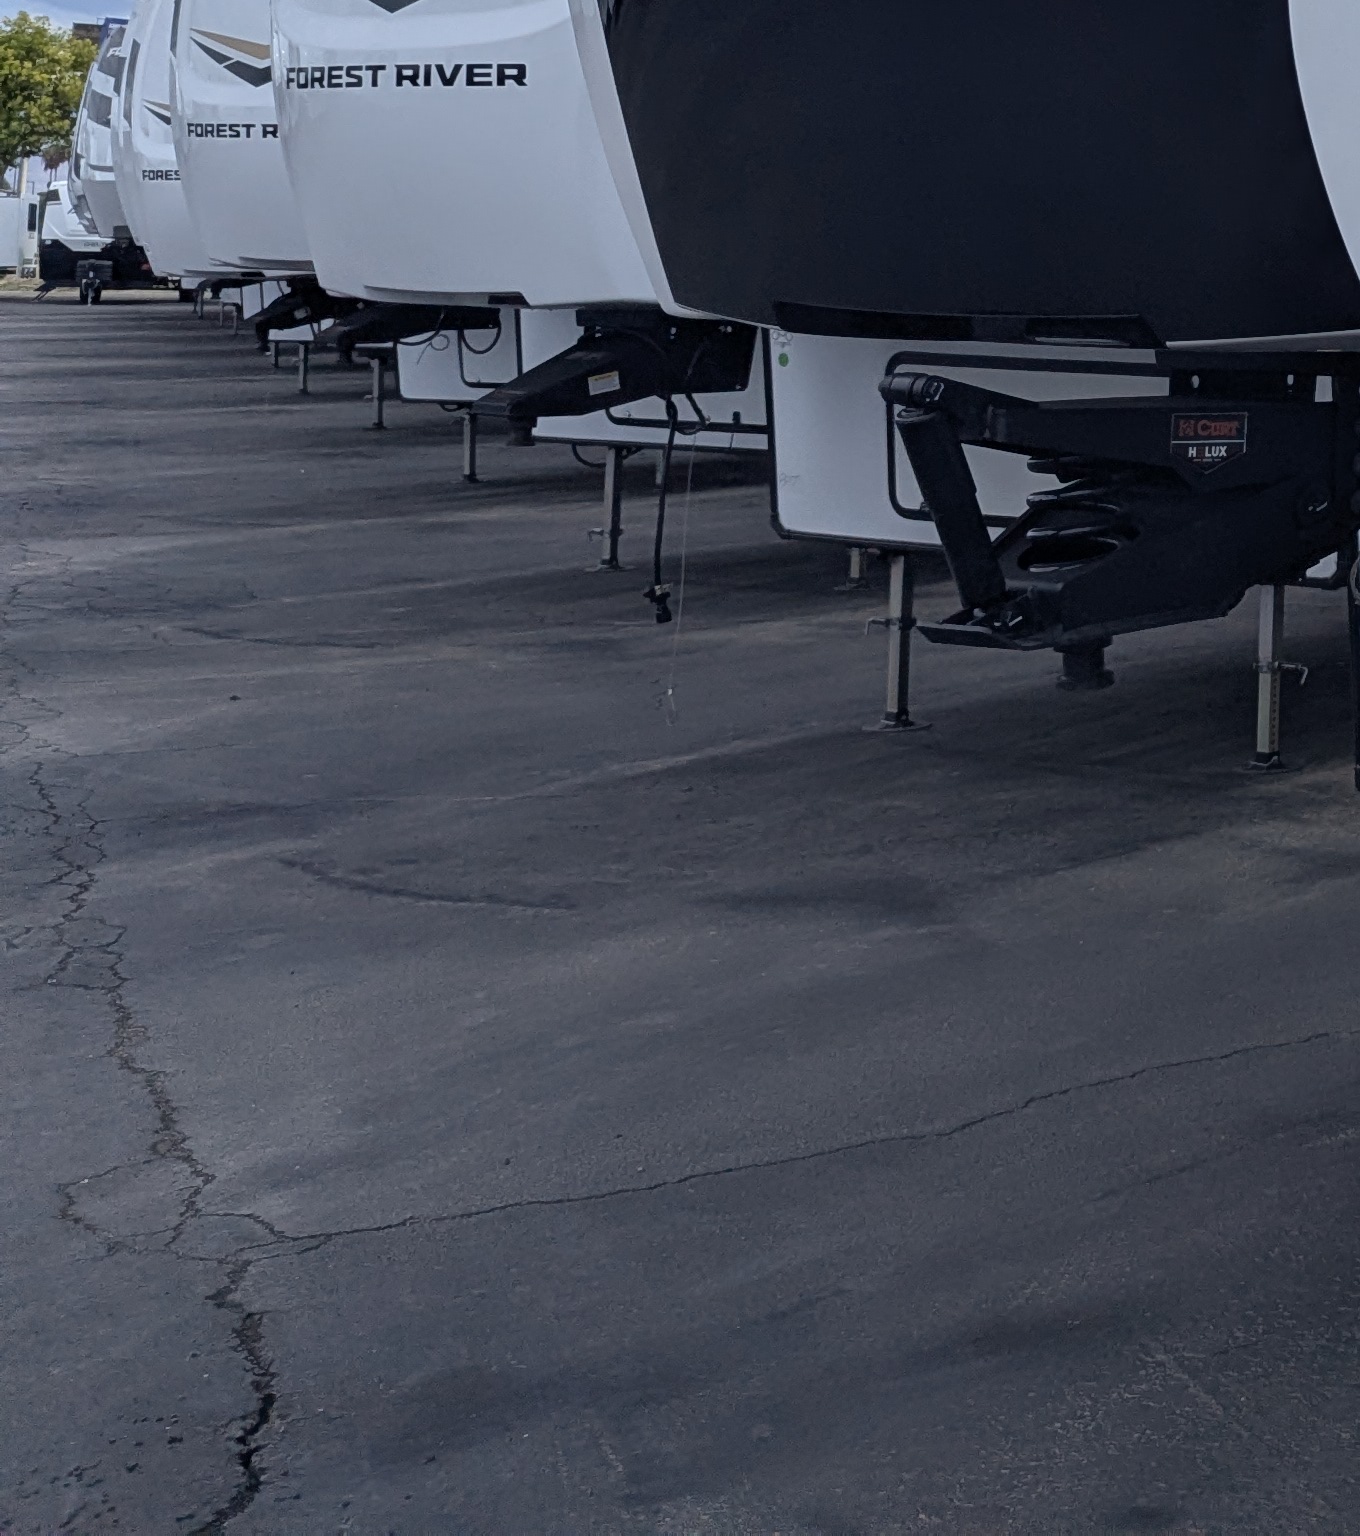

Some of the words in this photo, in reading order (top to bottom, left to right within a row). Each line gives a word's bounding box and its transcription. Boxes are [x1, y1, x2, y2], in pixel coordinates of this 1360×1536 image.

[285, 64, 387, 90] FOREST
[394, 63, 529, 88] RIVER
[187, 122, 257, 139] FOREST
[142, 169, 182, 182] FORES
